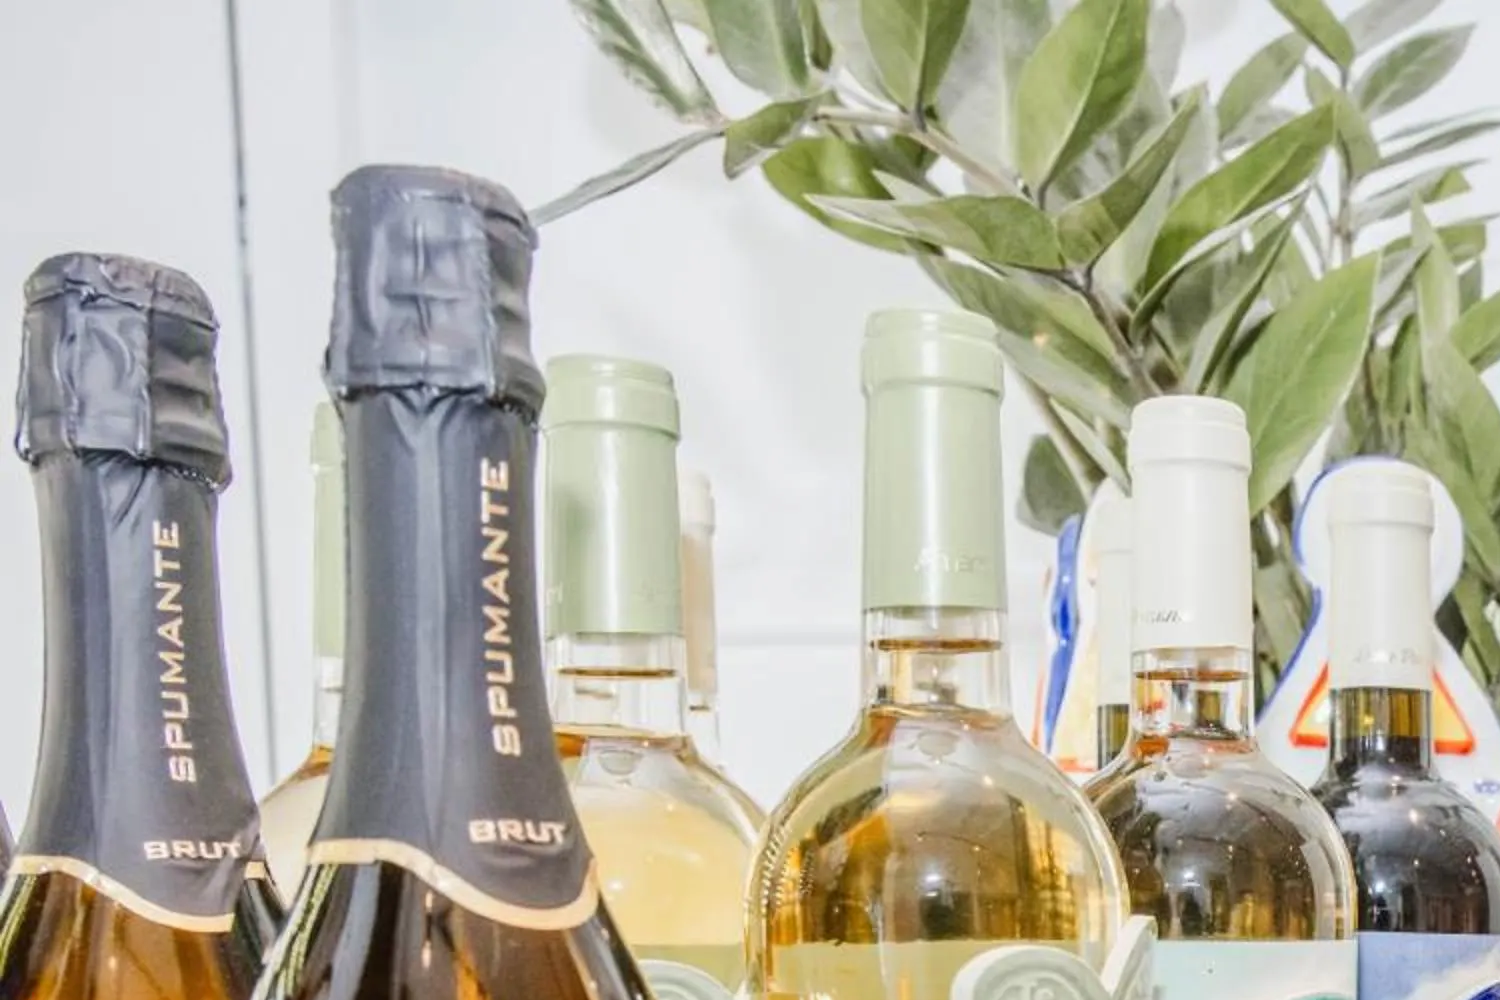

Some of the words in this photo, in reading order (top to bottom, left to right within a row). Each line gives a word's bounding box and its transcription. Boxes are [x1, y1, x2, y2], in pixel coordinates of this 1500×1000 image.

[152, 519, 197, 783] SPUMANTE
[480, 458, 521, 757] SPUMANTE
[144, 840, 244, 863] BRUT
[468, 818, 567, 846] BRUT
